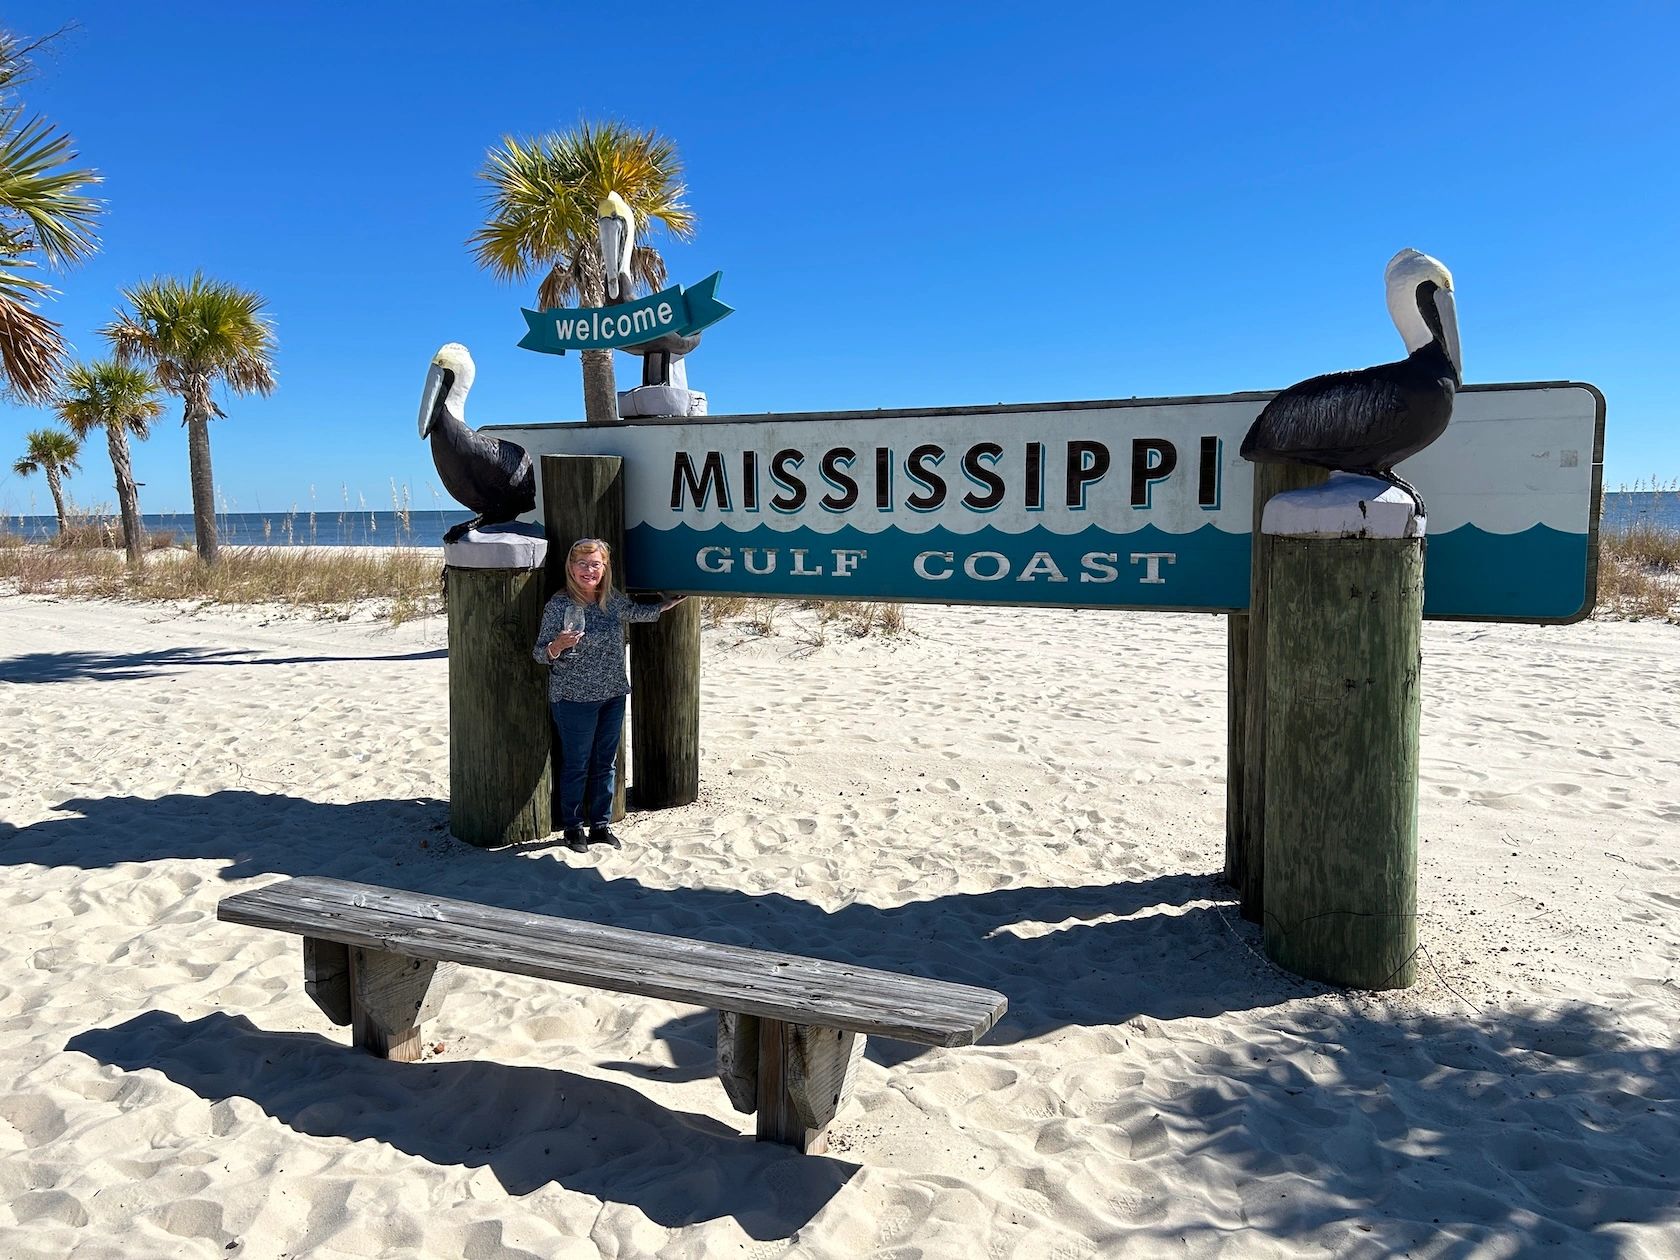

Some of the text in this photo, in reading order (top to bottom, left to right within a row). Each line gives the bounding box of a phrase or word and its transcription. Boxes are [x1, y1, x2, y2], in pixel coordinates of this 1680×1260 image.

[555, 301, 673, 341] welcome
[670, 435, 1221, 512] MISSISSIPPI
[695, 545, 1177, 584] GULF COAST
